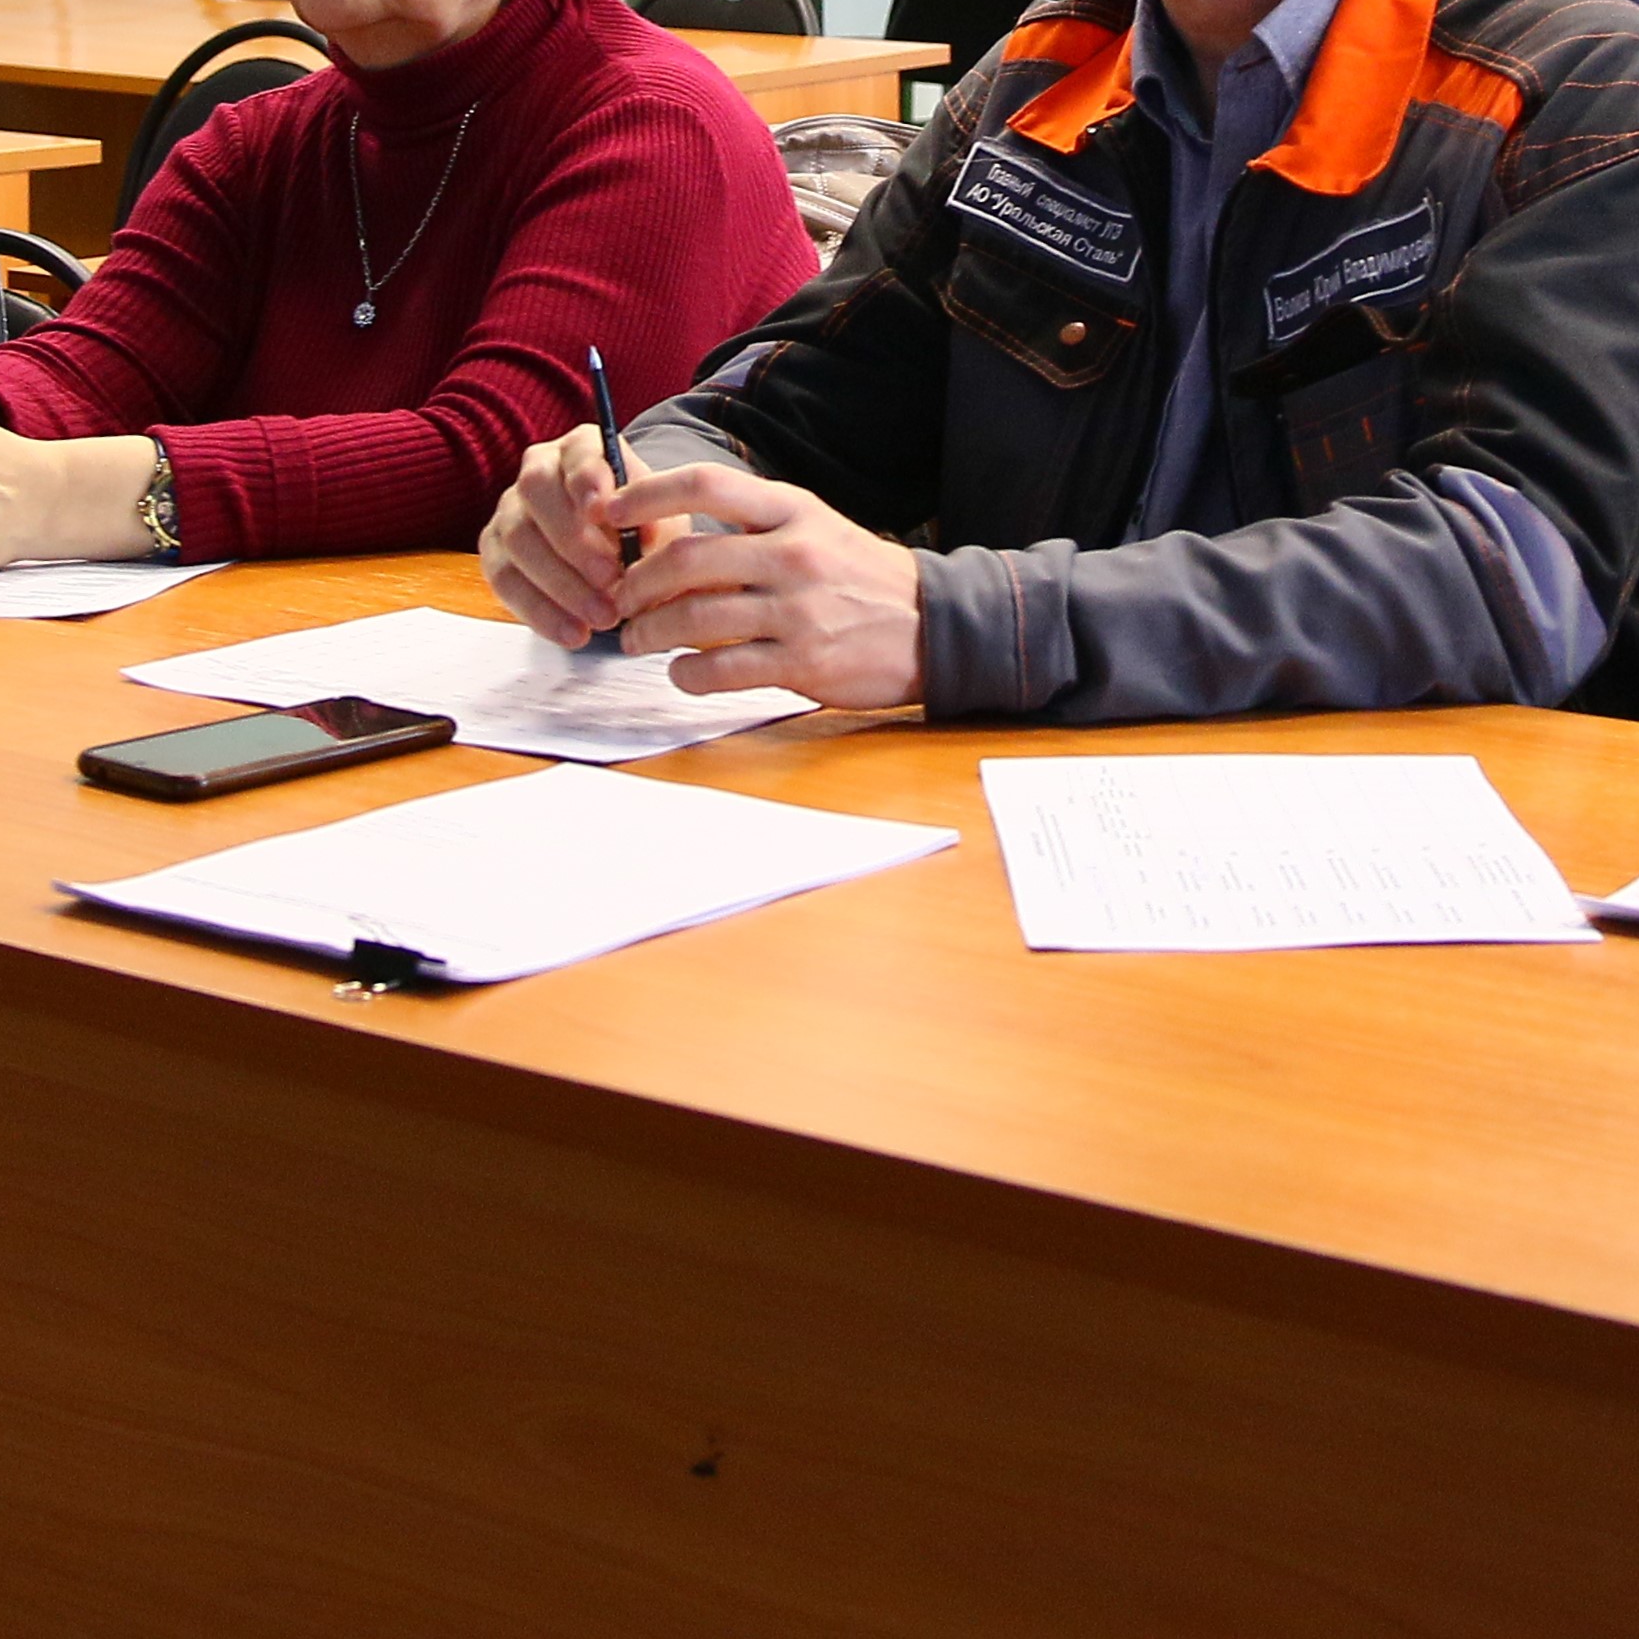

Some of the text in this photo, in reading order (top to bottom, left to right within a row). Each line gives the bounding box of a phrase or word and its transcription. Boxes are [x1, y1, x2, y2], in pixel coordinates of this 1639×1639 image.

[965, 182, 991, 203] АО
[985, 163, 1036, 198] Главный
[1035, 193, 1103, 232] специалист
